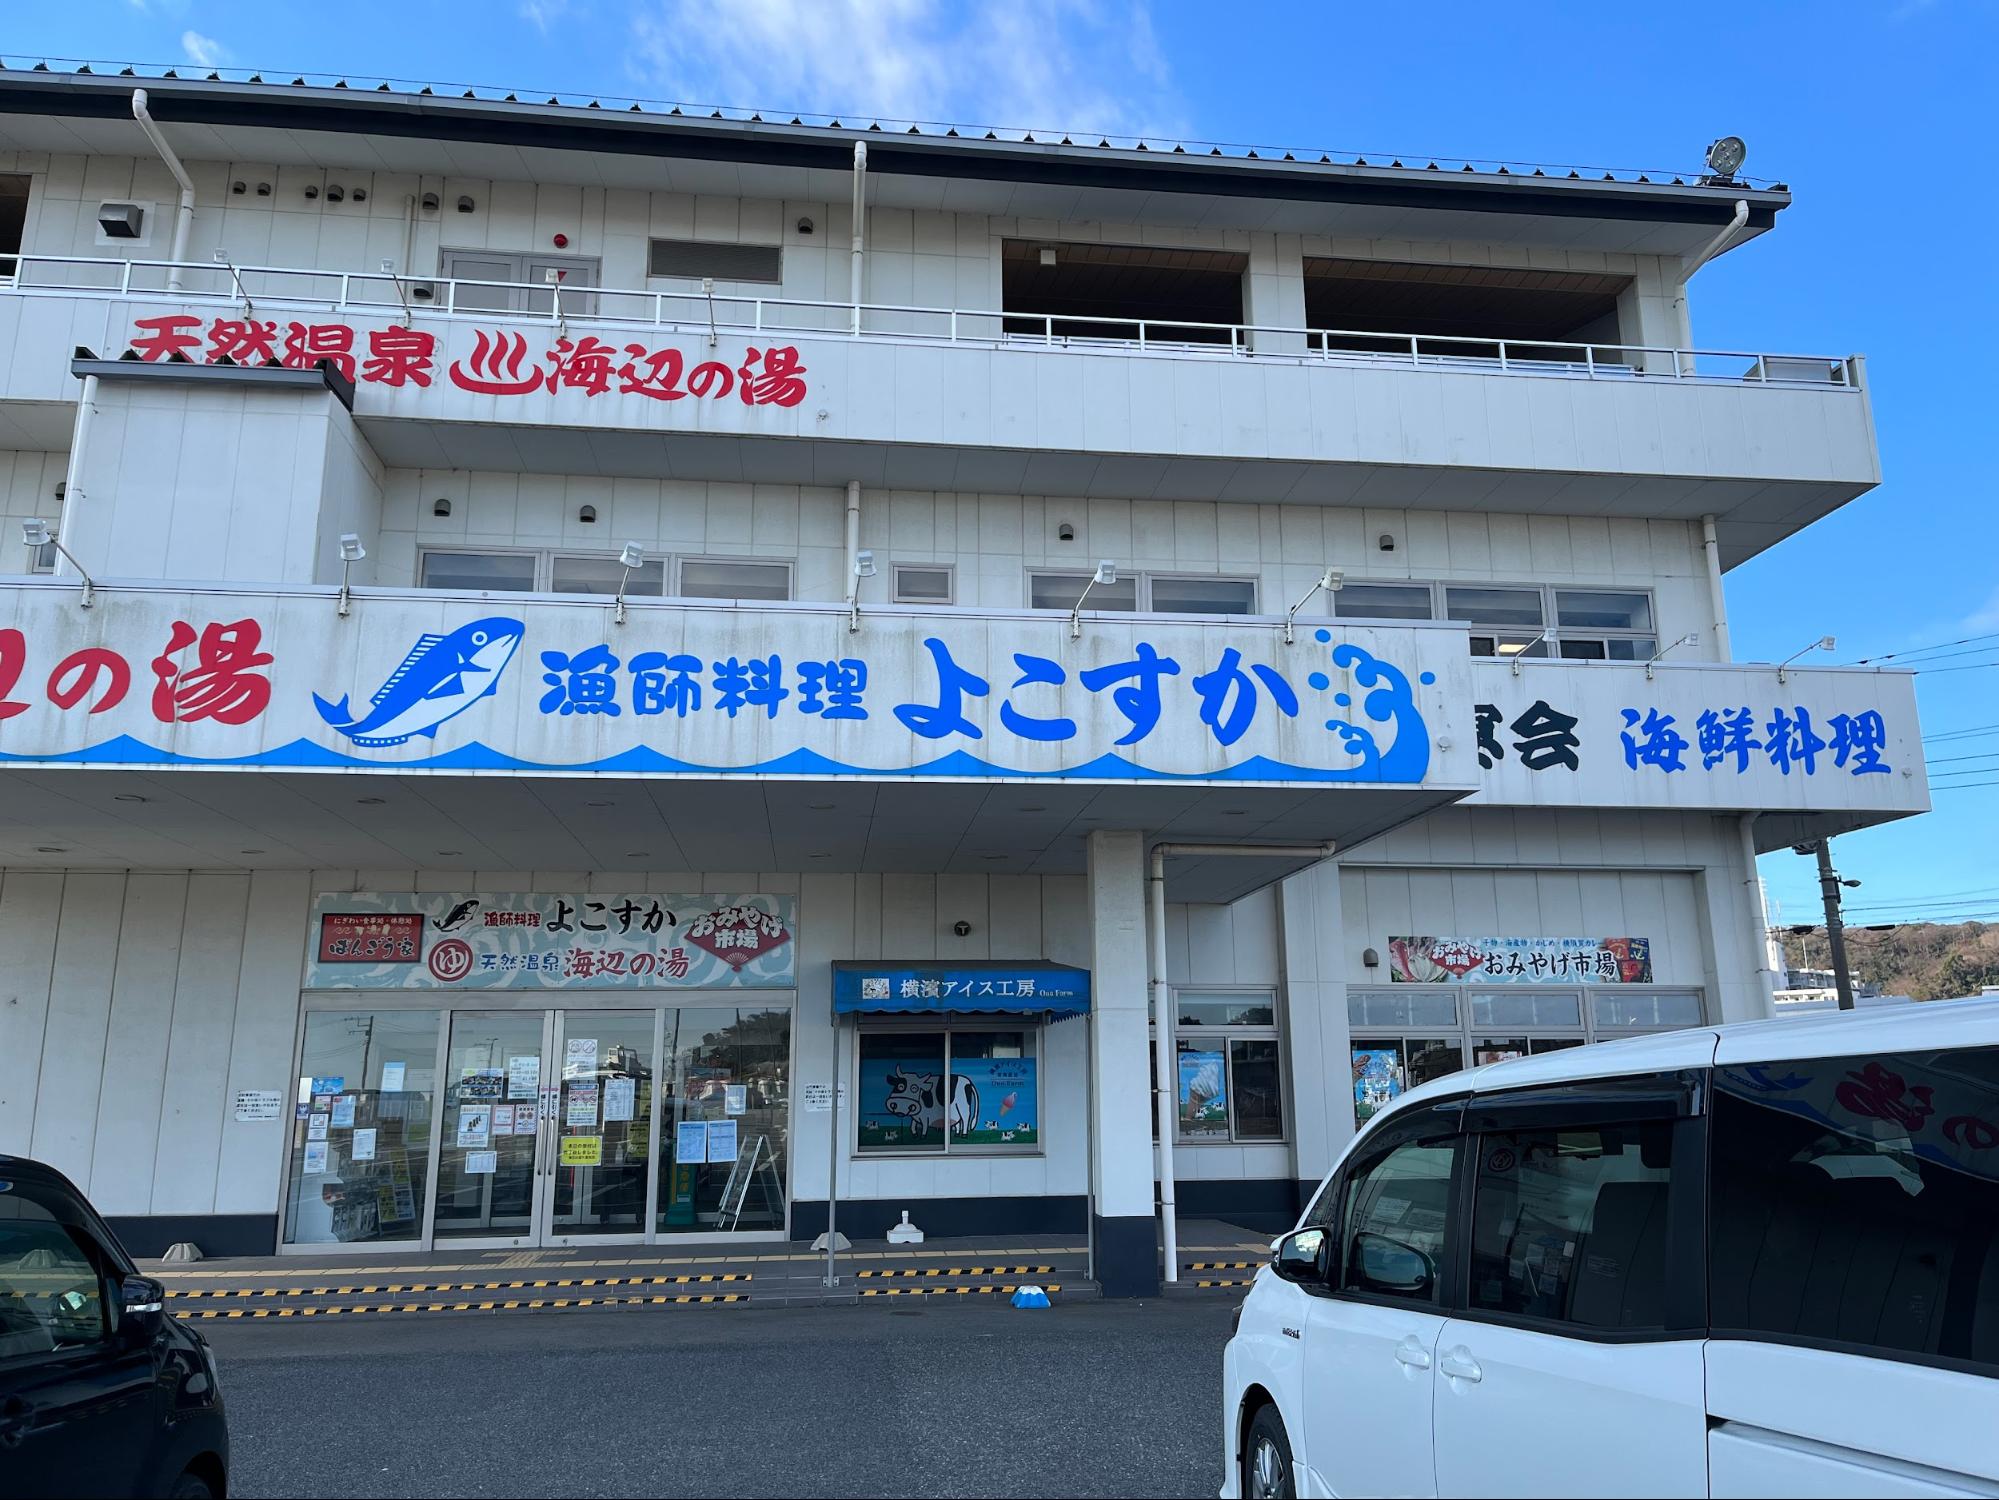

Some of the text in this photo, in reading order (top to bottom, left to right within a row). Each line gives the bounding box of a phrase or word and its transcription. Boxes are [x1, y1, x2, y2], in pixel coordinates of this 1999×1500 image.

[132, 316, 806, 407] 天然温泉 海辺の湯
[539, 638, 1299, 746] 漁師料理 よこすか
[1620, 705, 1892, 776] 海鮮料理
[484, 899, 678, 935] 漁師料理 よこすか
[692, 906, 784, 938] おみやげ
[714, 928, 759, 949] 市場
[1432, 941, 1486, 960] おみやげ
[481, 947, 691, 979] 天然温泉 海辺の湯
[1445, 954, 1470, 967] 市場
[1484, 951, 1618, 978] おみやげ市場
[900, 978, 1035, 998] 横濱アイス工房
